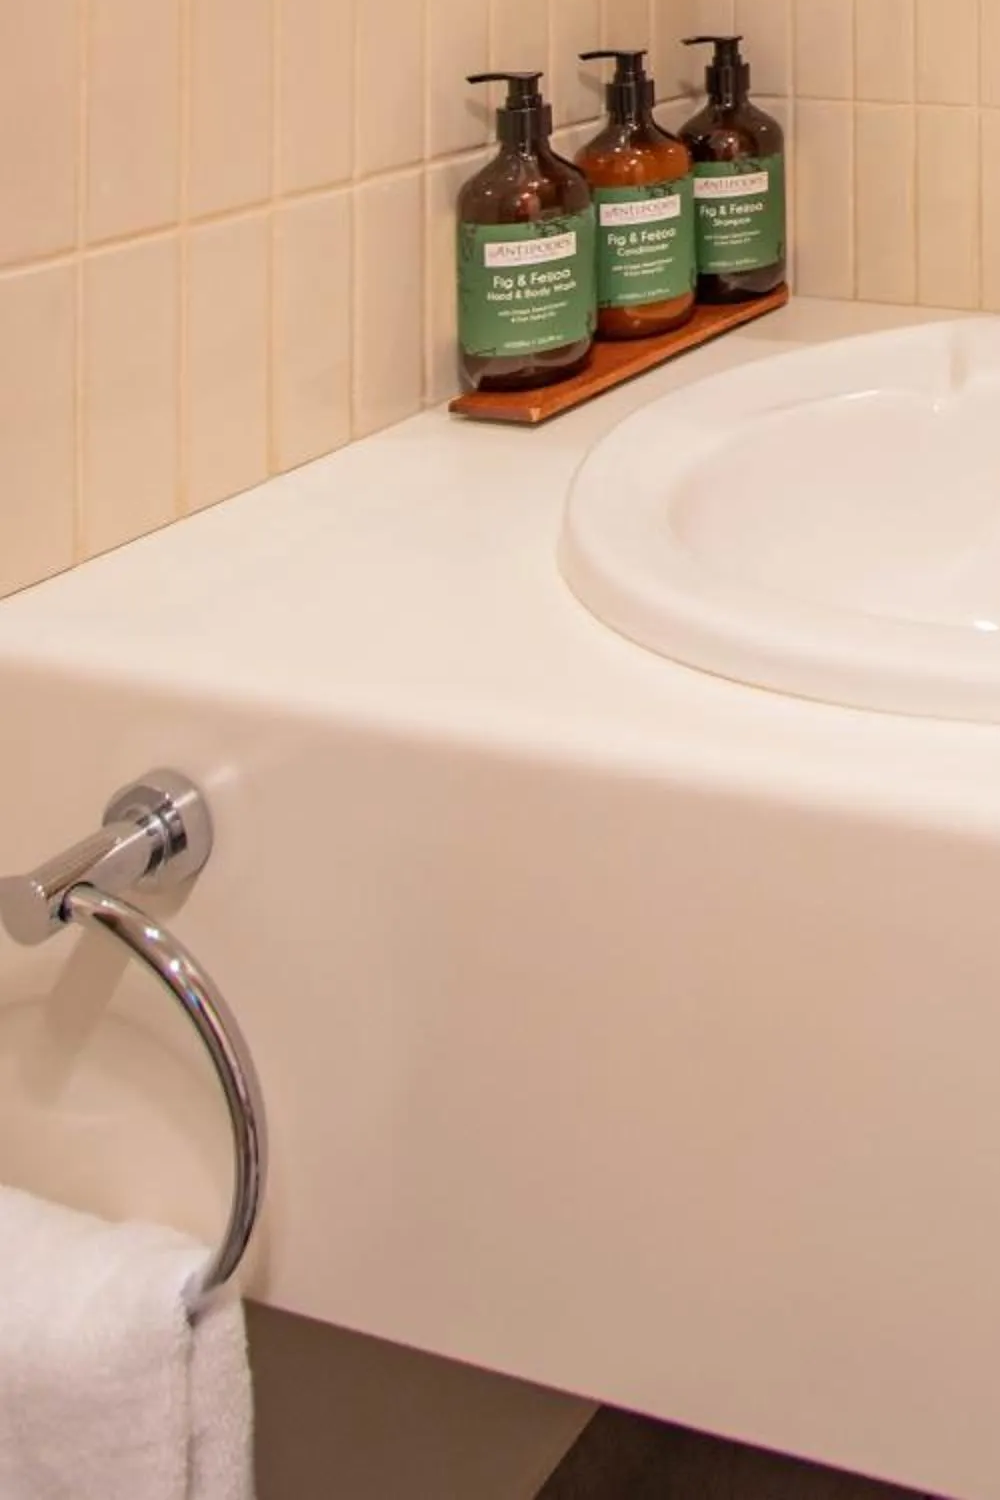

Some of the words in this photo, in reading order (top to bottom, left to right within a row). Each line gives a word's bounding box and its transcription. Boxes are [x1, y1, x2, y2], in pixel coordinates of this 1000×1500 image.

[607, 232, 627, 247] Fig
[629, 231, 638, 244] &
[493, 275, 514, 290] Fig
[517, 273, 527, 288] &
